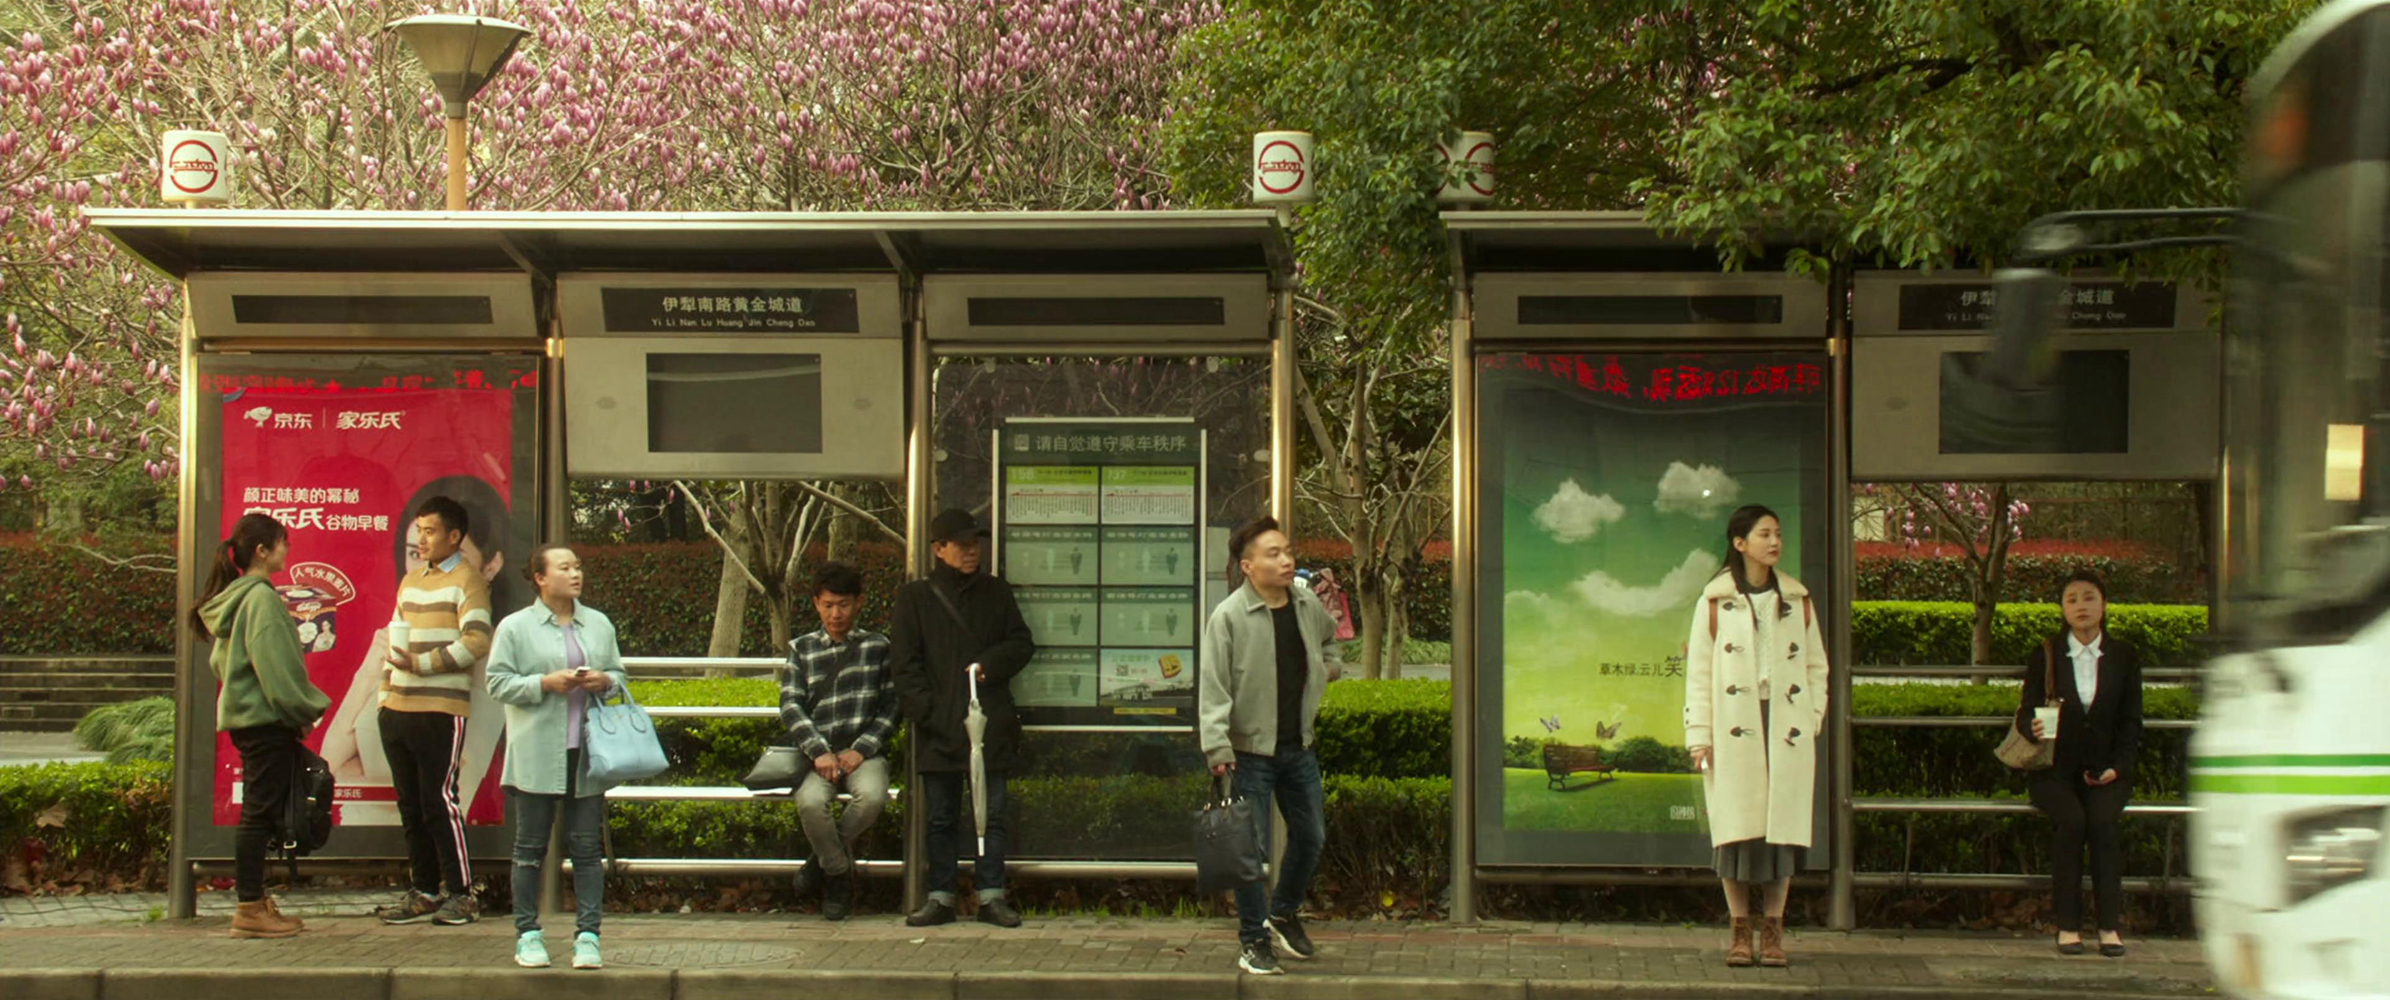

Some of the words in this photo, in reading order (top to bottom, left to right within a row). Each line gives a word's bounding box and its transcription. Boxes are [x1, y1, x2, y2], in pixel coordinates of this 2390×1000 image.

[662, 296, 803, 313] 伊犁南路黄金城道
[1961, 289, 2114, 306] 伊犁金城道
[652, 318, 661, 326] Yi
[667, 318, 675, 326] Li
[680, 318, 697, 326] Nan
[702, 318, 712, 326] Lu
[717, 318, 743, 328] Huang
[748, 318, 762, 326] Jin
[767, 318, 793, 328] Cheng
[799, 318, 815, 326] Dao
[274, 412, 312, 429] 京东
[336, 411, 402, 430] 家乐氏
[1036, 434, 1186, 452] 请自觉遵守乘车秩序
